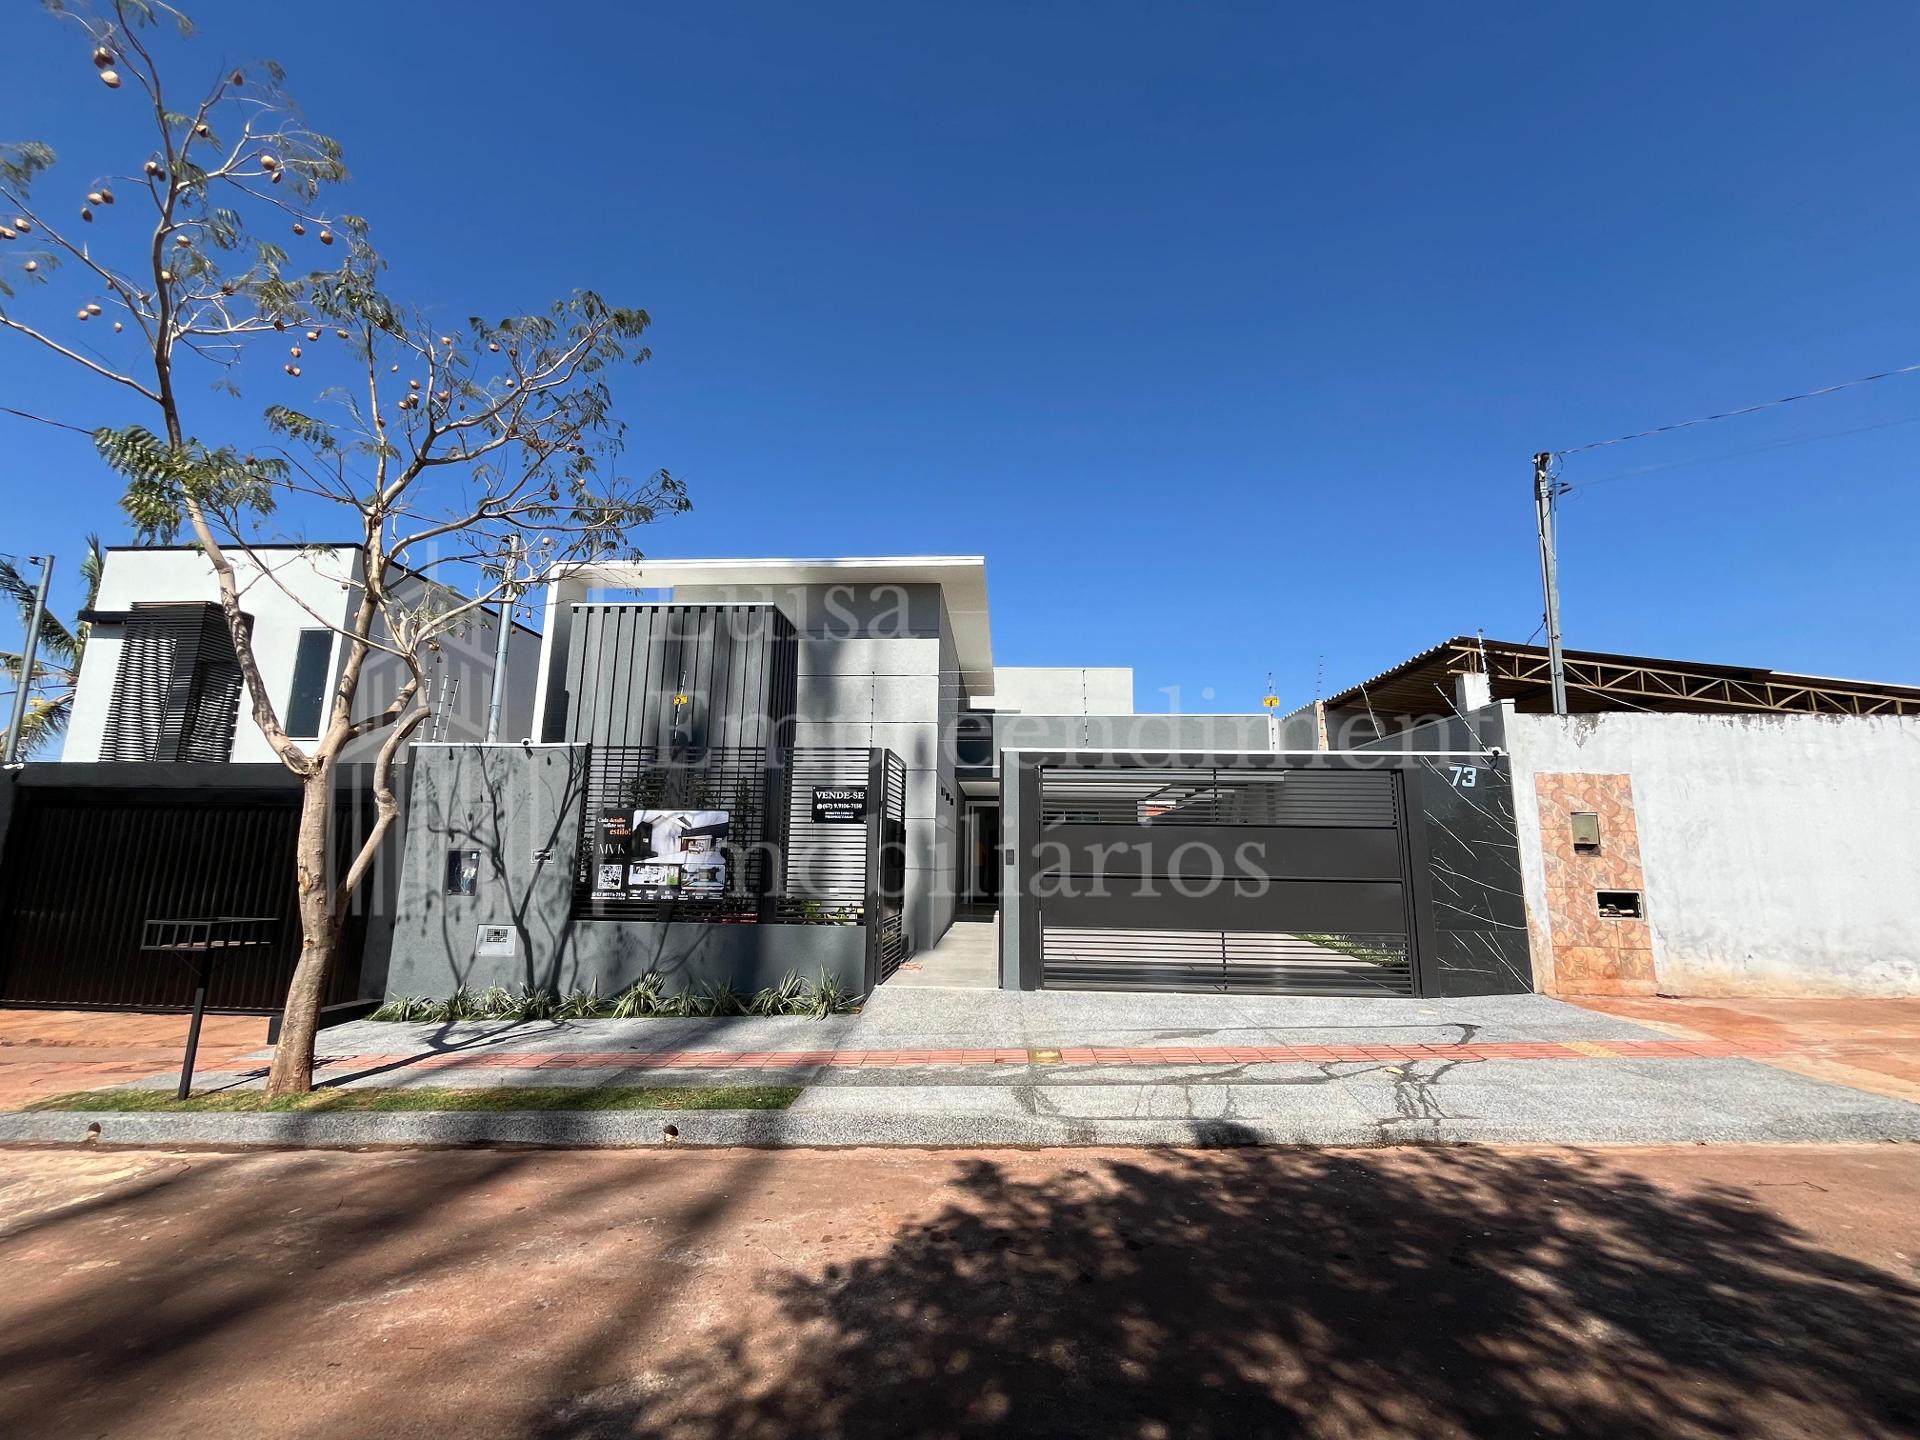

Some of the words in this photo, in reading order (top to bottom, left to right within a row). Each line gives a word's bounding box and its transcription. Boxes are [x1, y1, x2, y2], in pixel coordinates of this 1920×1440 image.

[1449, 766, 1477, 788] 73
[815, 791, 865, 800] VENDE-SE
[609, 827, 631, 835] estilo!
